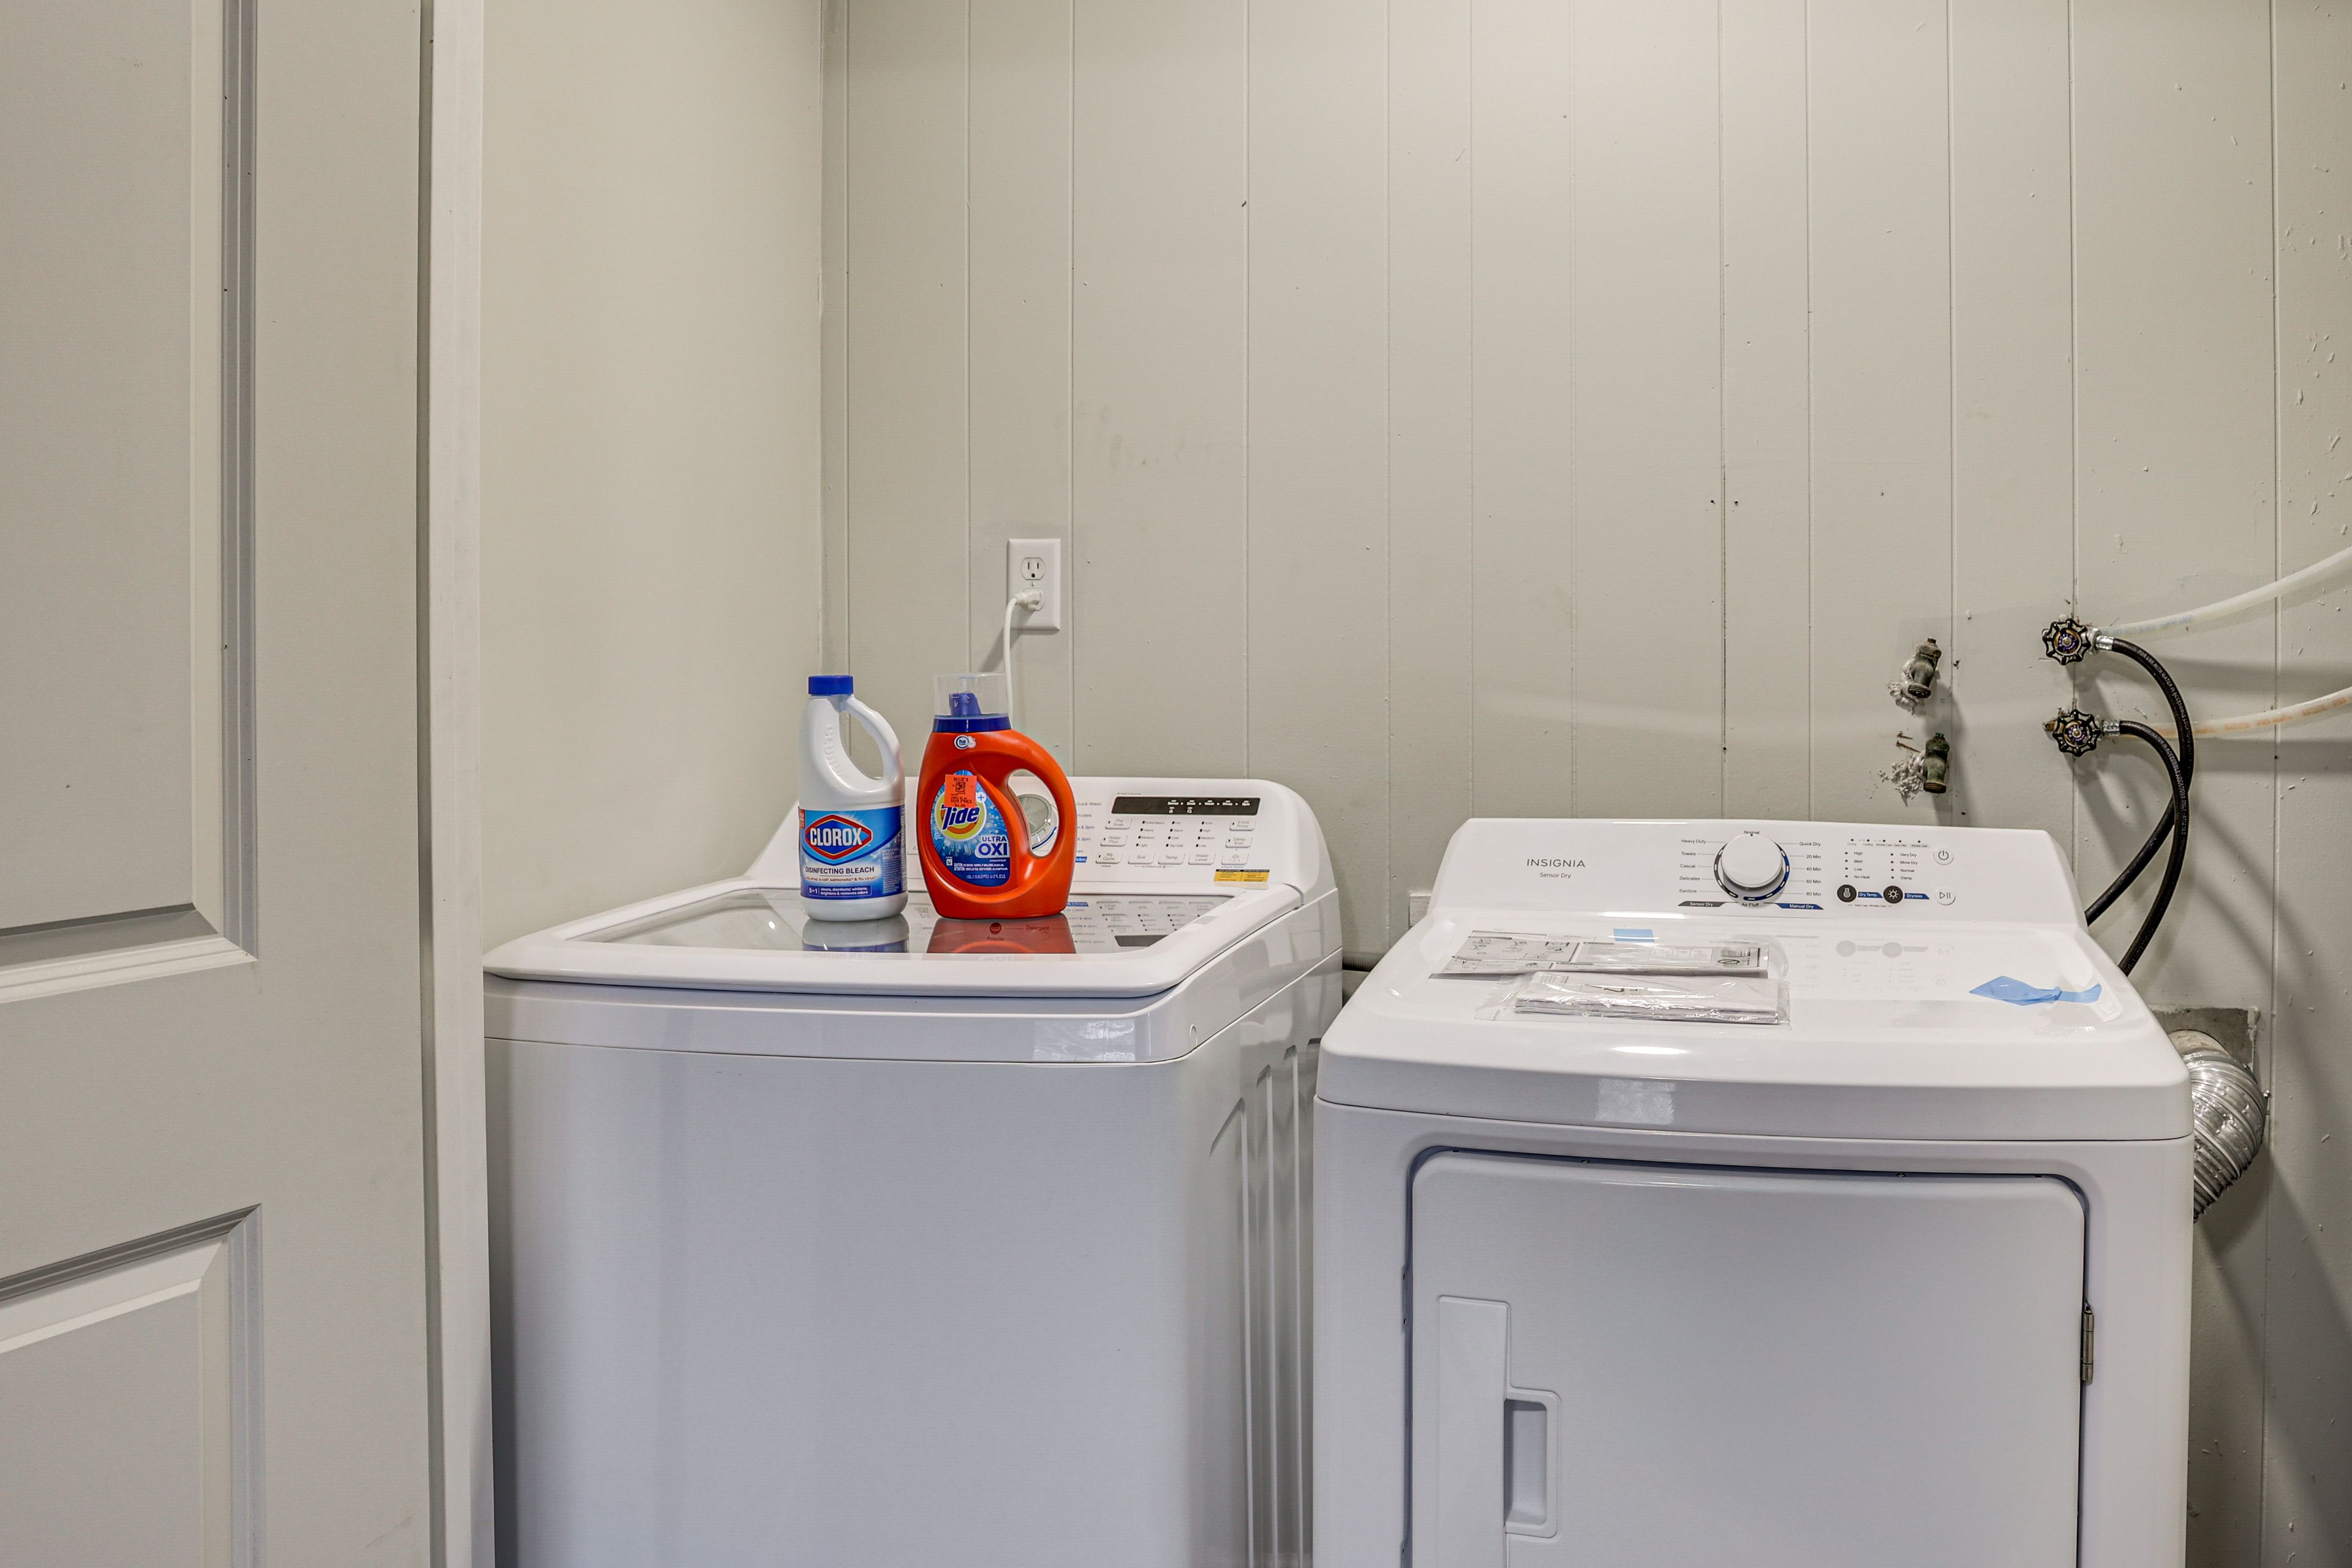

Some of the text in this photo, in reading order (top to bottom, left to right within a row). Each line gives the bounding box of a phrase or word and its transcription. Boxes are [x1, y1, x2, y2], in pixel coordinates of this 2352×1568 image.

[941, 804, 980, 830] Tide
[810, 827, 863, 846] CLOROX
[978, 843, 1008, 856] OXI
[1527, 859, 1586, 867] INSIGNIA
